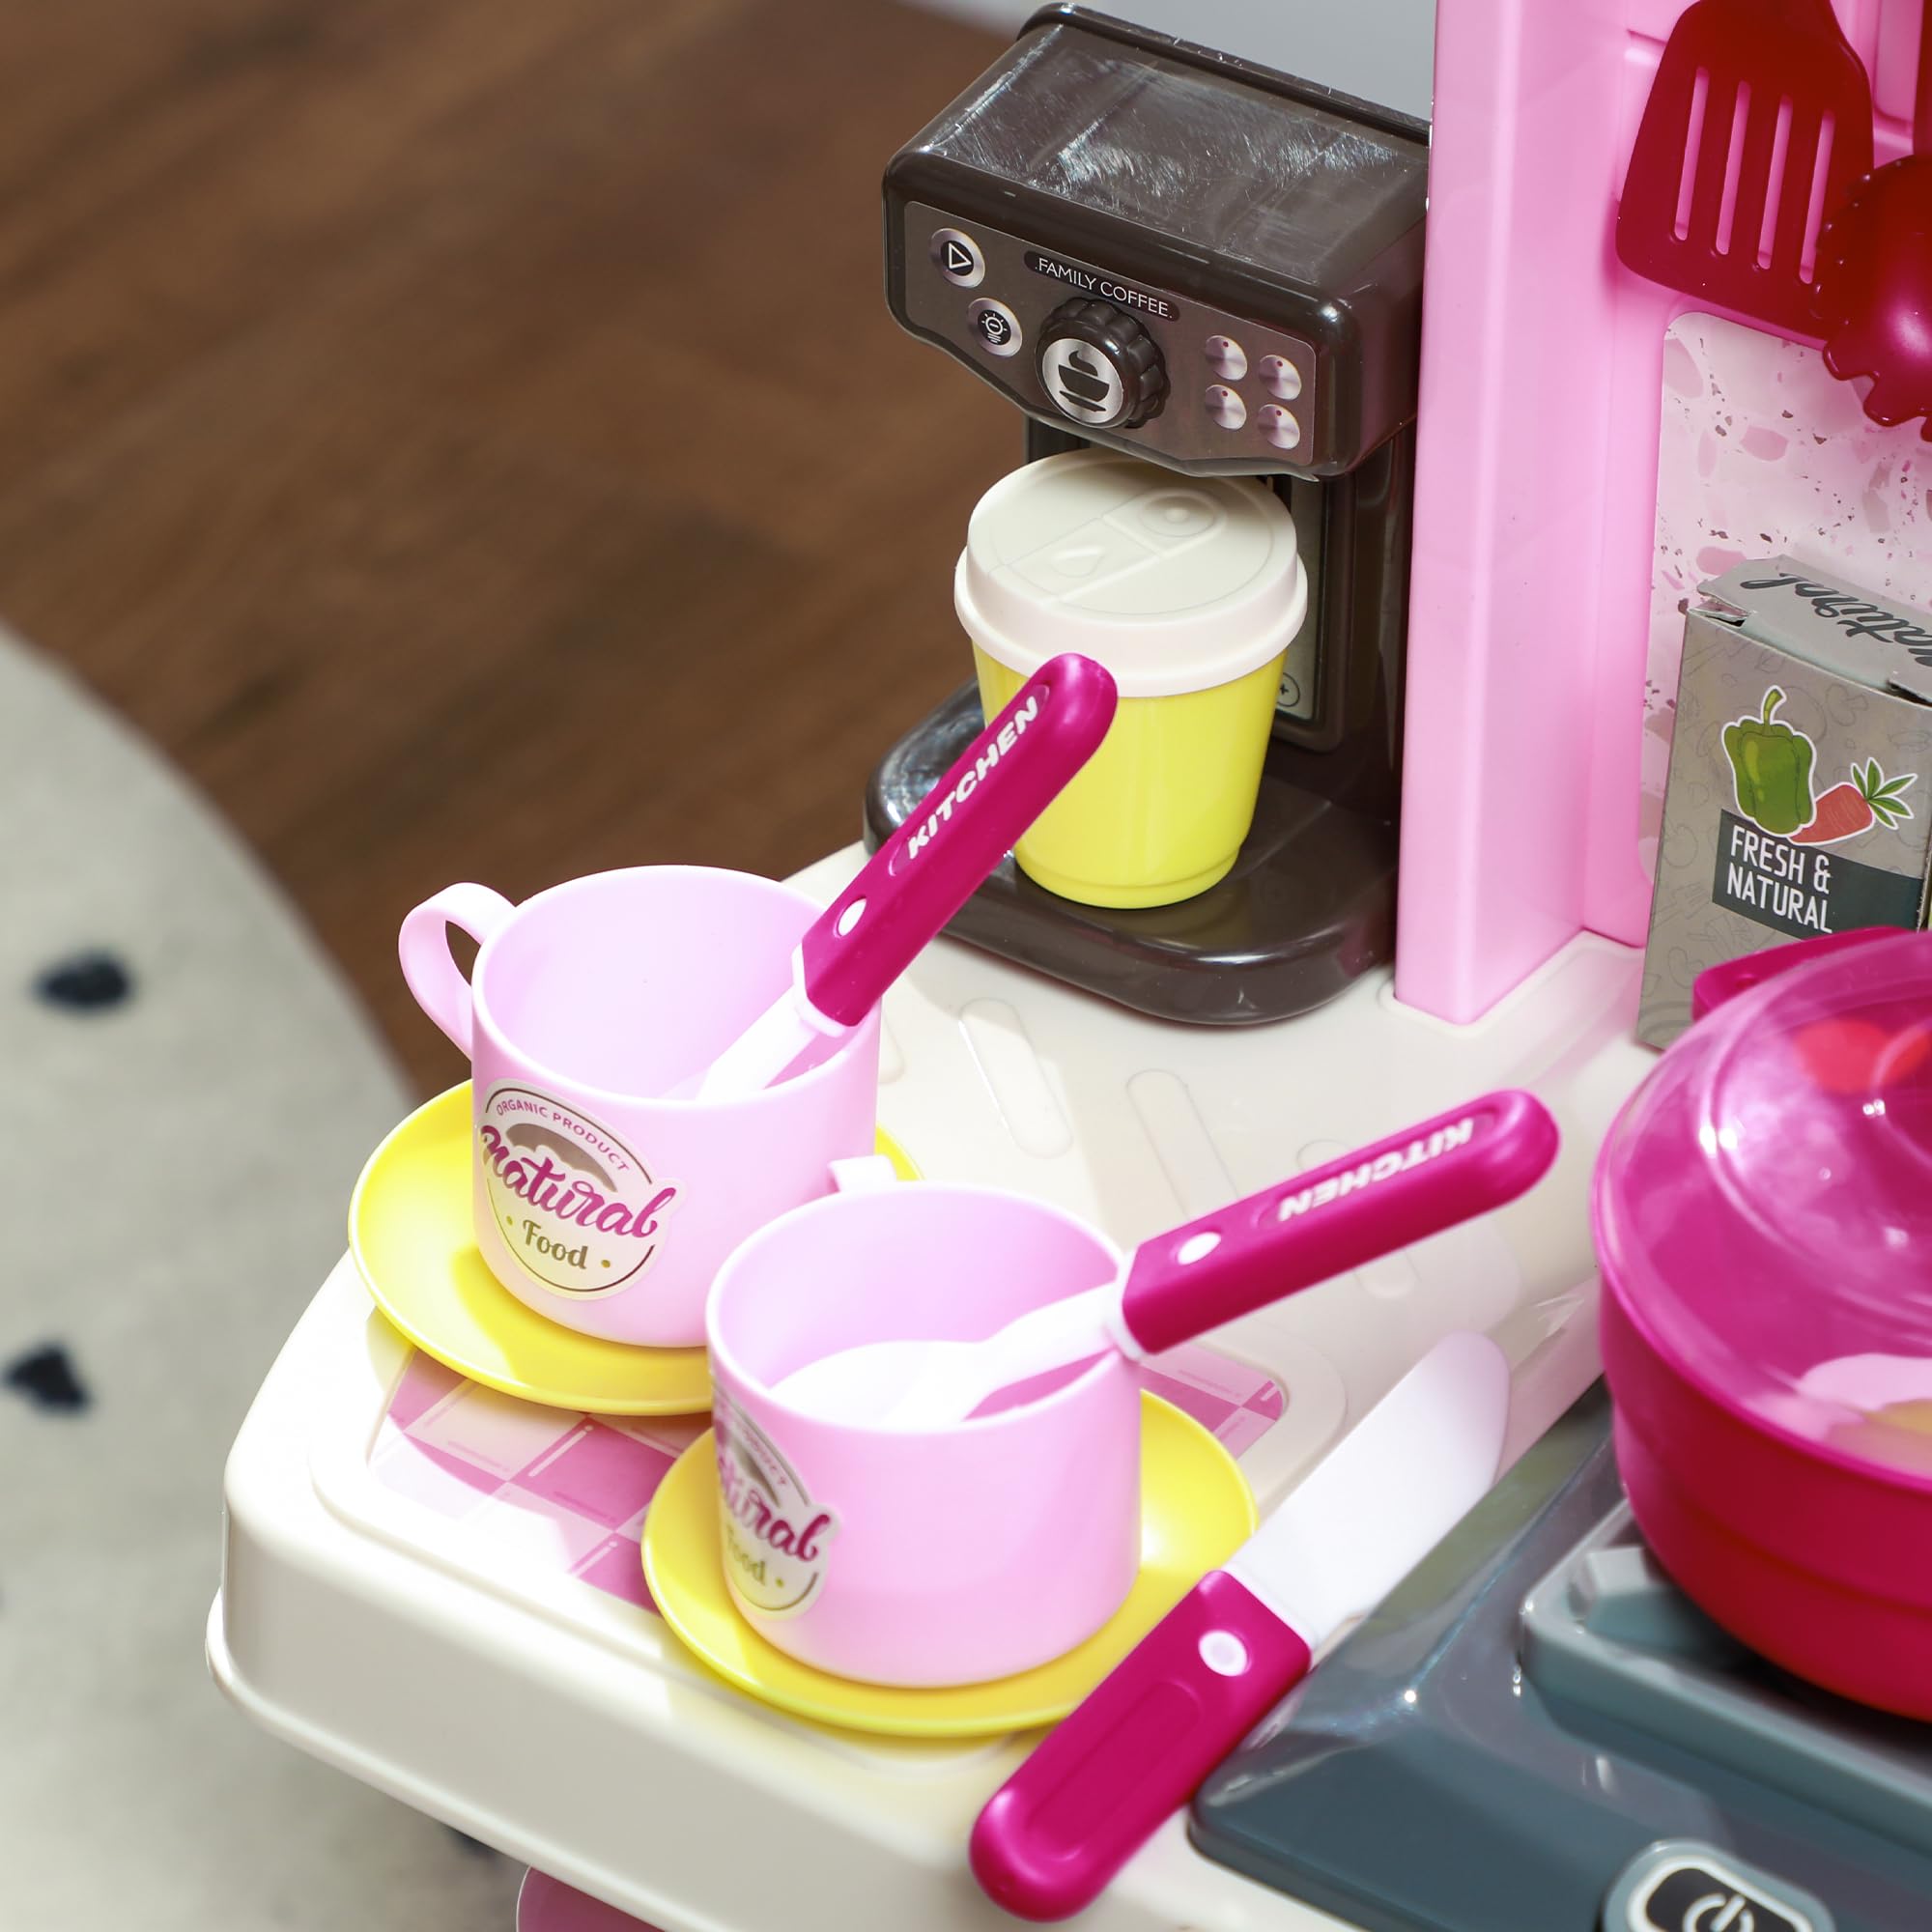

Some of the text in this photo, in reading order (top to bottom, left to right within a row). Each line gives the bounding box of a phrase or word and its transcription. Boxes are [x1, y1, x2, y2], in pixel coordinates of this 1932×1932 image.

[907, 696, 1038, 859] KITCHEN
[1730, 824, 1833, 895] FRESH &
[1727, 862, 1833, 934] NATURAL
[496, 1098, 630, 1171] ORGANIC PRODUCT
[1277, 1118, 1474, 1222] KITCHEN
[480, 1124, 676, 1238] natural
[522, 1218, 589, 1269] Food
